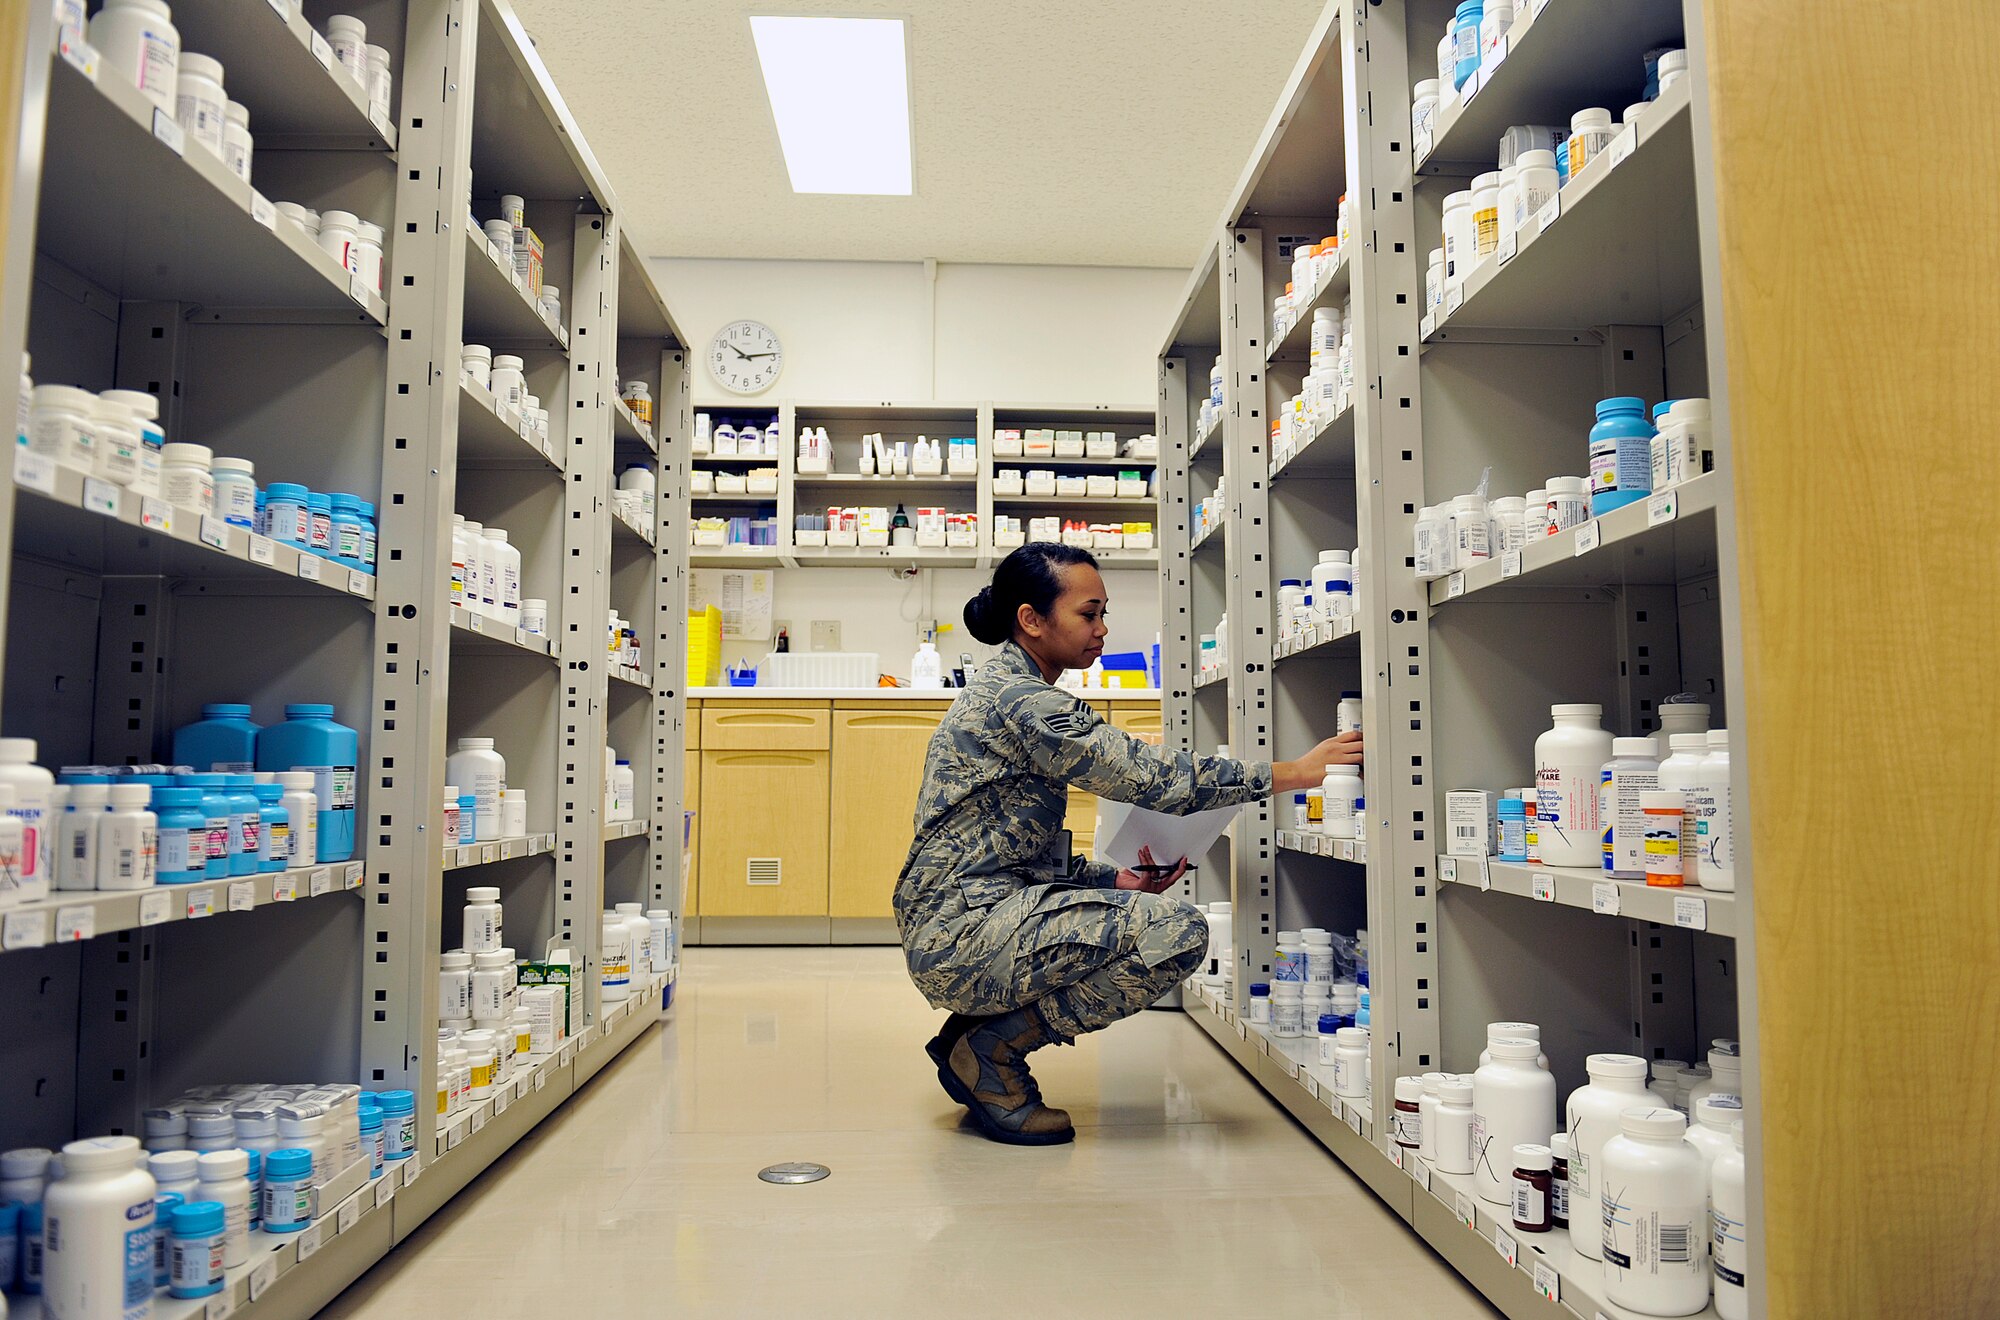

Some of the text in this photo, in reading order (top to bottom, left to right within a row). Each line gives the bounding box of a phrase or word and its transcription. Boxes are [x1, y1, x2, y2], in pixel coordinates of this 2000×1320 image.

[730, 330, 737, 339] 11
[742, 326, 750, 336] 12
[758, 330, 761, 339] 1
[719, 340, 728, 348] 10
[766, 340, 772, 348] 2
[716, 352, 722, 361] 9
[770, 353, 776, 361] 3
[720, 365, 726, 374] 8
[766, 366, 772, 374] 4
[731, 374, 737, 383] 7
[743, 378, 749, 387] 6
[755, 374, 761, 383] 5
[1703, 808, 1716, 817] USP
